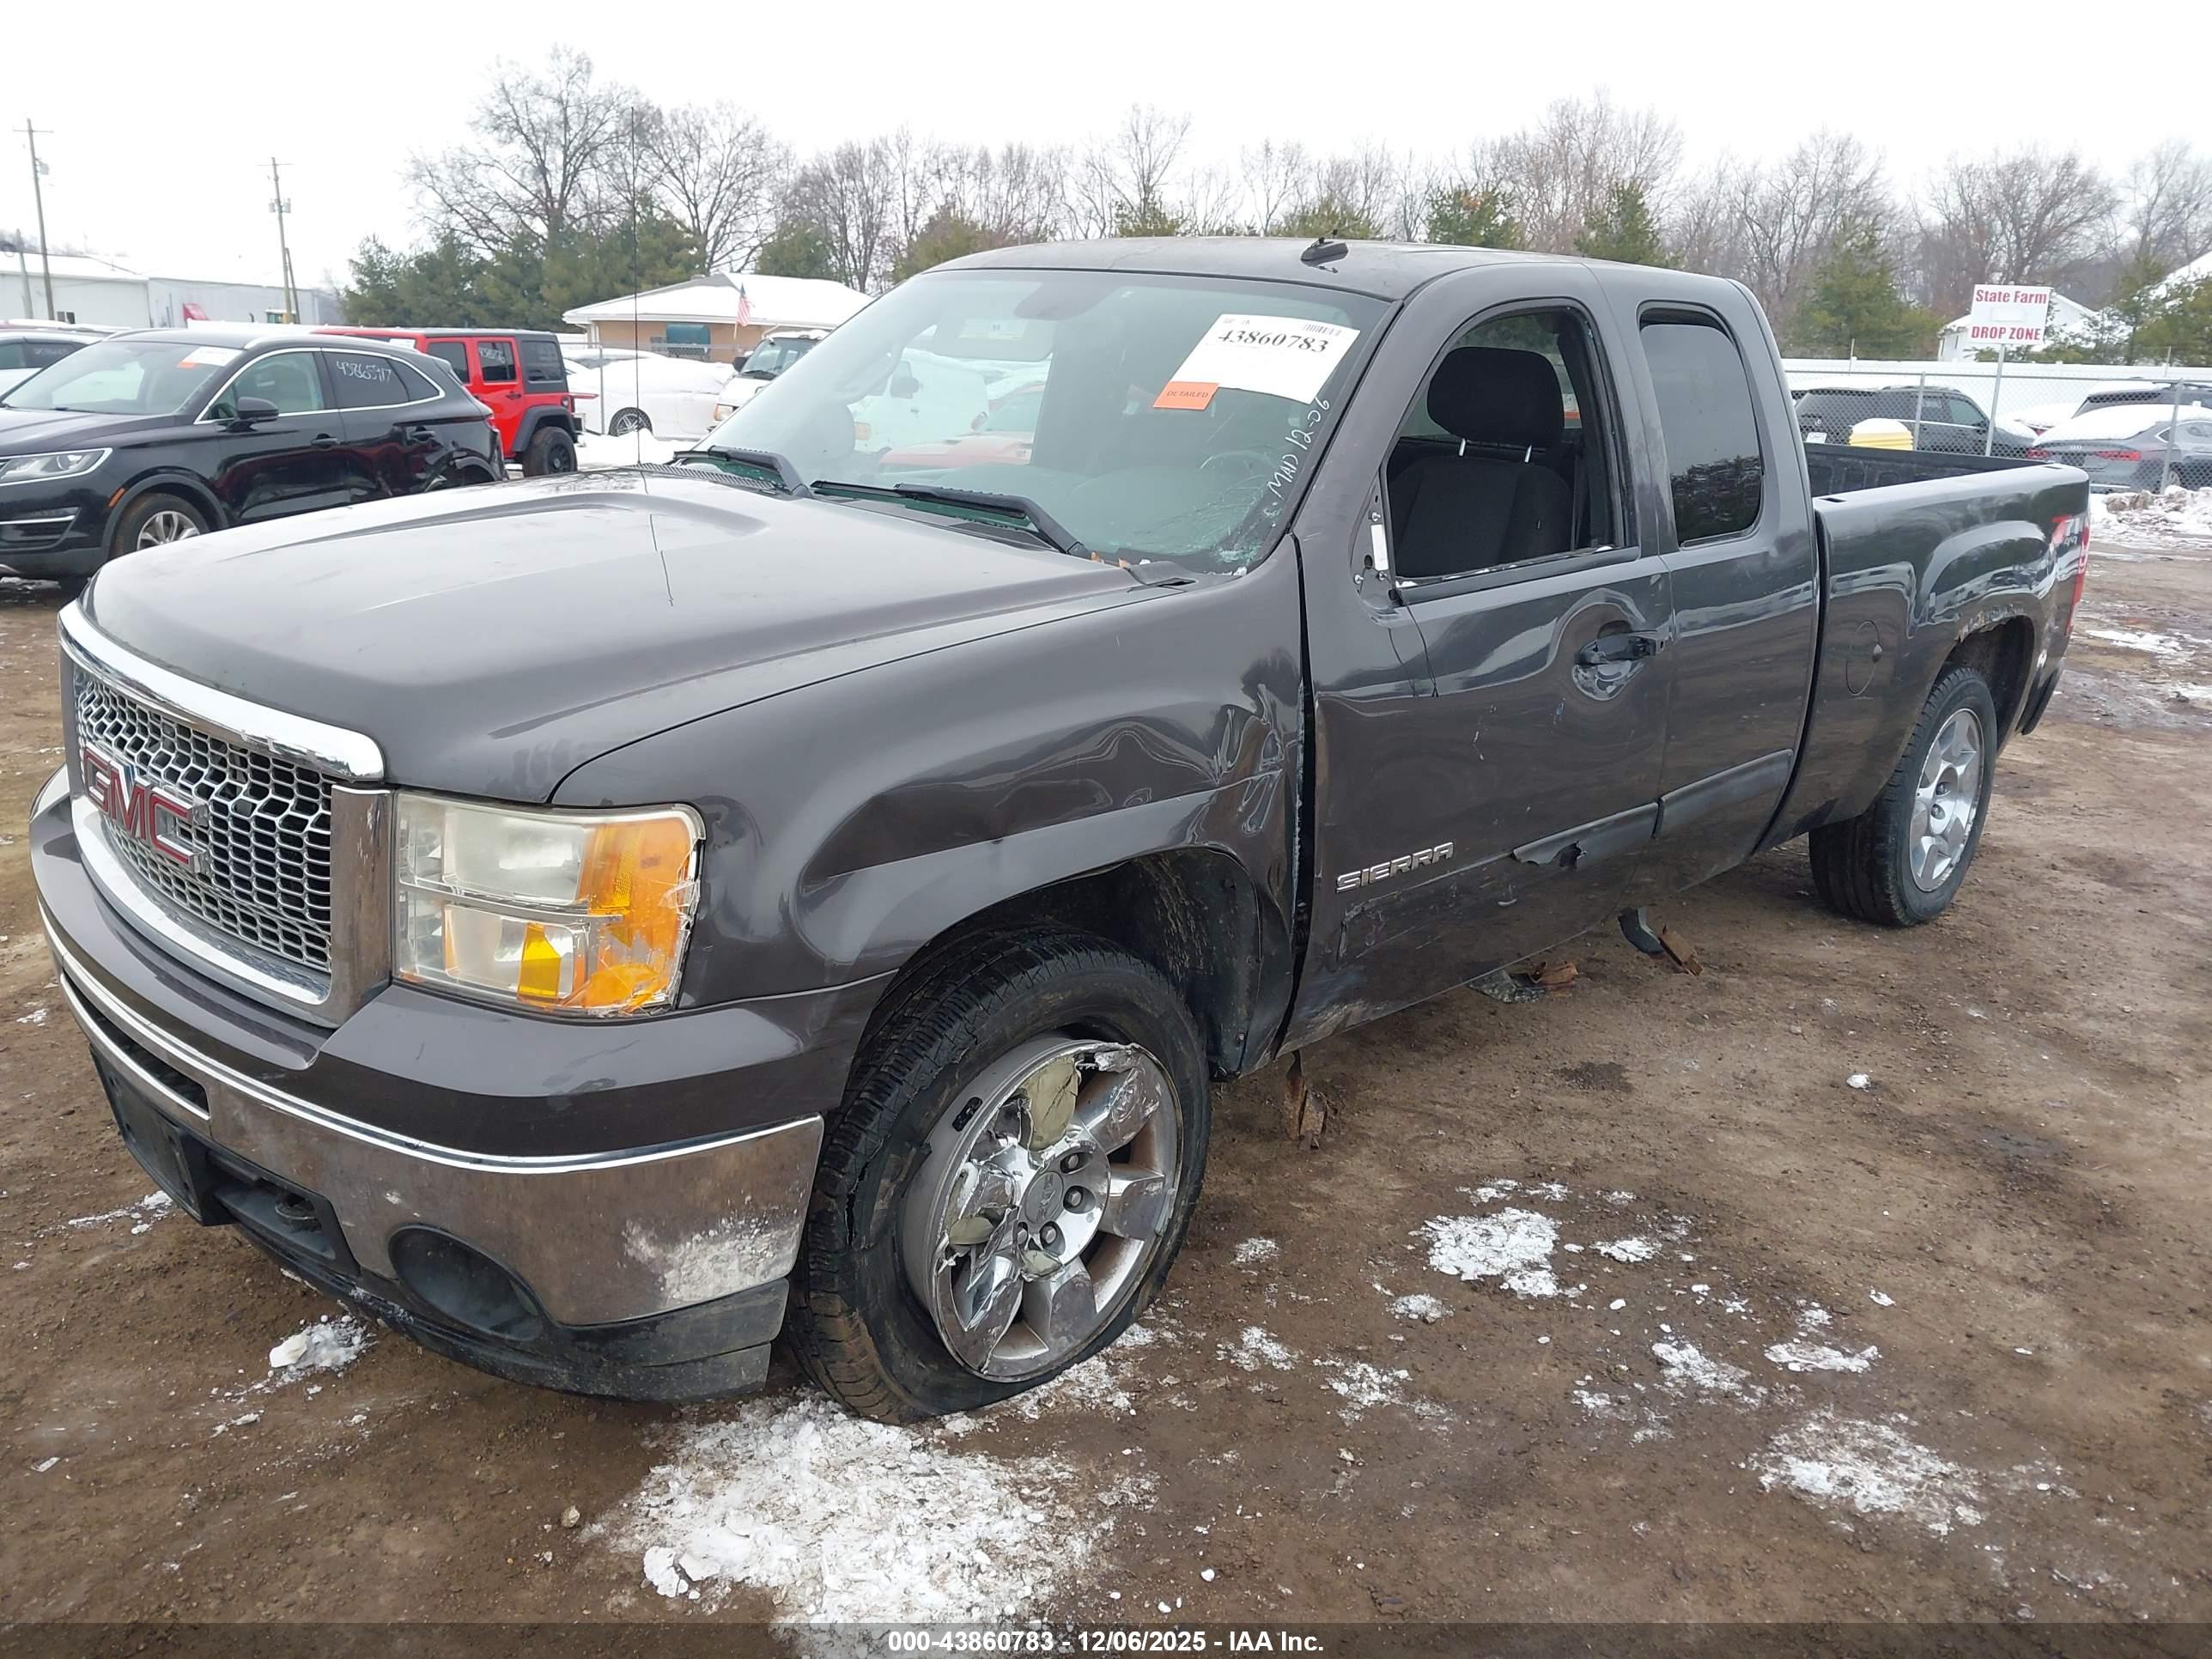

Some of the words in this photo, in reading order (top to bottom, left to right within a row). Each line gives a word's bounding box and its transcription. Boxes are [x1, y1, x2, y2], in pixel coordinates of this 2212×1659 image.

[1976, 289, 2010, 302] State
[2014, 291, 2047, 304] Farm
[1218, 329, 1329, 353] 43860783
[1971, 325, 2007, 339] DROP
[2008, 327, 2041, 341] ZONE
[1285, 397, 1330, 450] 12-06
[83, 742, 206, 870] GMC
[1336, 842, 1454, 893] SIERRA
